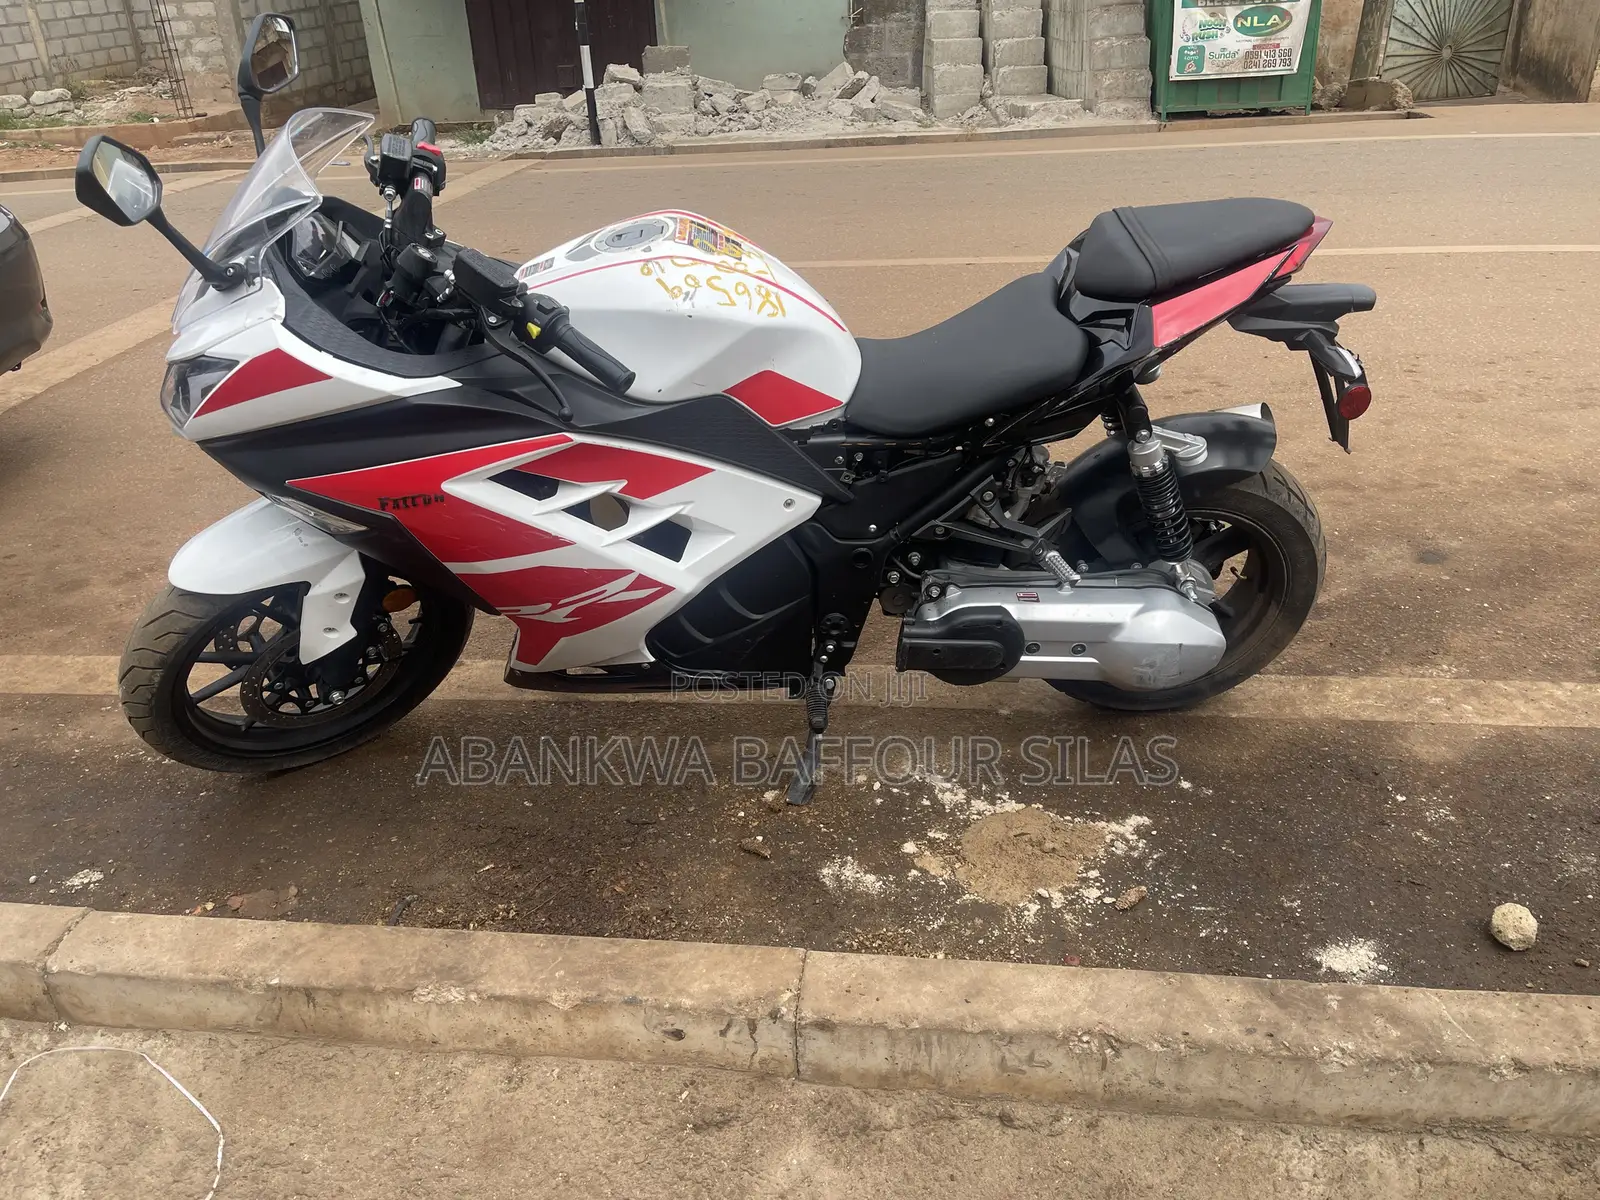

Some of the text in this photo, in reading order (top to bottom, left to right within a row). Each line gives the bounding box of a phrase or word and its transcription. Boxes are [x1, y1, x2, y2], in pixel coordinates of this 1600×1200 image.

[1237, 14, 1280, 28] NLA
[1192, 31, 1218, 41] RUSH
[1264, 49, 1276, 59] 413
[1278, 48, 1293, 58] 560
[1244, 60, 1260, 70] 0241
[1262, 58, 1277, 68] 269
[1279, 57, 1292, 67] 793
